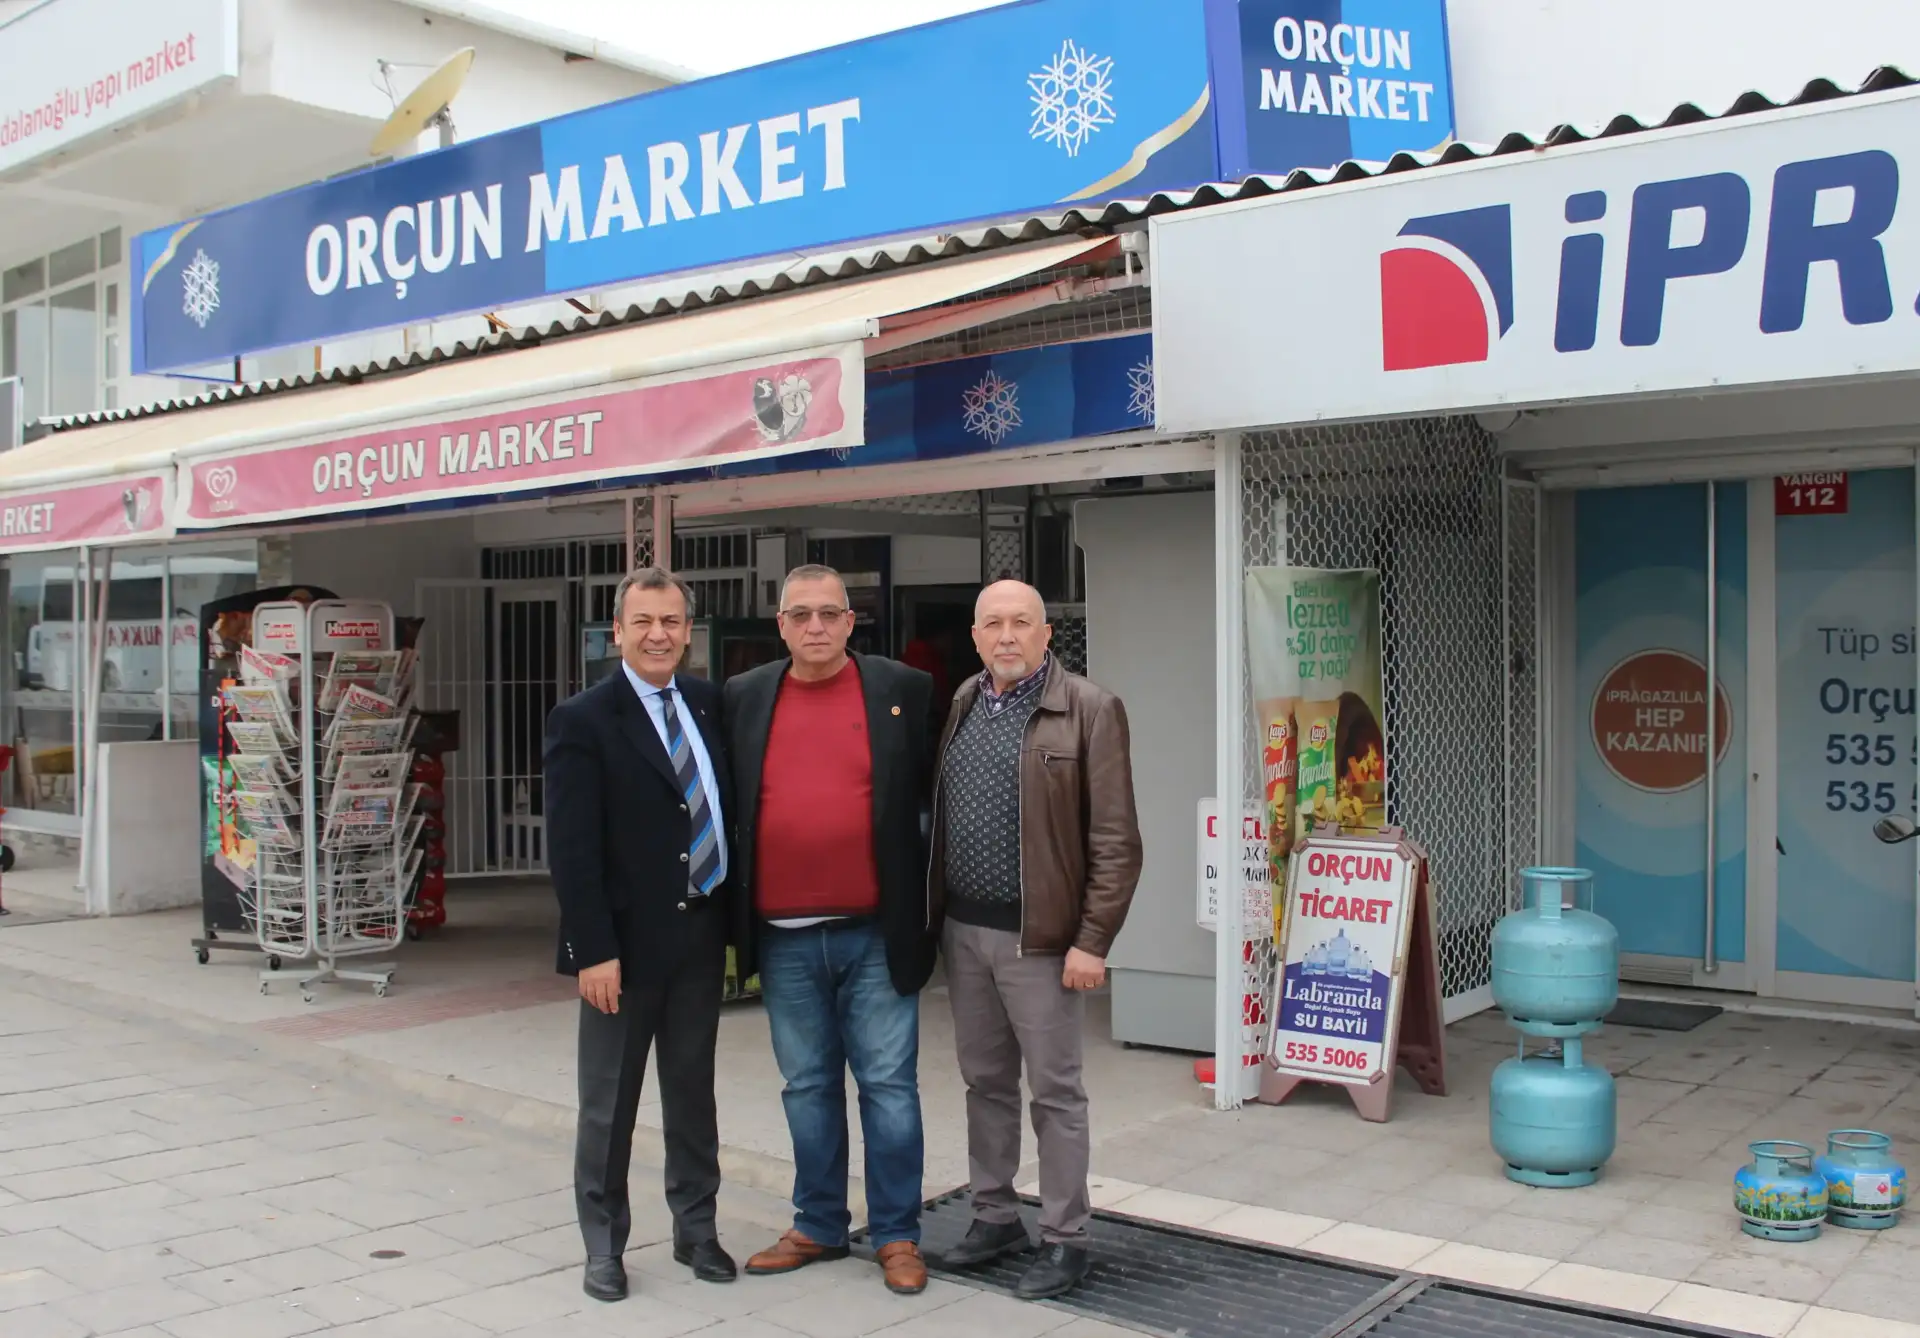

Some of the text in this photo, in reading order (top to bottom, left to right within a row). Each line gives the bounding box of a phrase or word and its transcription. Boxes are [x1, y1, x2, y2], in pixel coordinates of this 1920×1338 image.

[1273, 16, 1412, 76] ORÇUN
[0, 32, 196, 147] dalanoğlu yapı market
[1258, 68, 1434, 122] MARKET
[305, 97, 861, 300] ORÇUN MARKET
[312, 410, 602, 497] ORÇUN MARKET
[1790, 488, 1835, 507] 112
[0, 502, 56, 538] RKET
[1818, 627, 1879, 660] Tüp
[1299, 661, 1316, 678] az
[1819, 678, 1916, 723] Orçu
[1636, 708, 1685, 728] HEP
[1826, 733, 1896, 767] 535
[1826, 780, 1896, 814] 535
[1308, 853, 1392, 885] ORÇUN
[1299, 887, 1393, 925] TİCARET
[1284, 978, 1382, 1011] Labranda
[1294, 1012, 1318, 1028] SU
[1285, 1042, 1368, 1070] 535 5006
